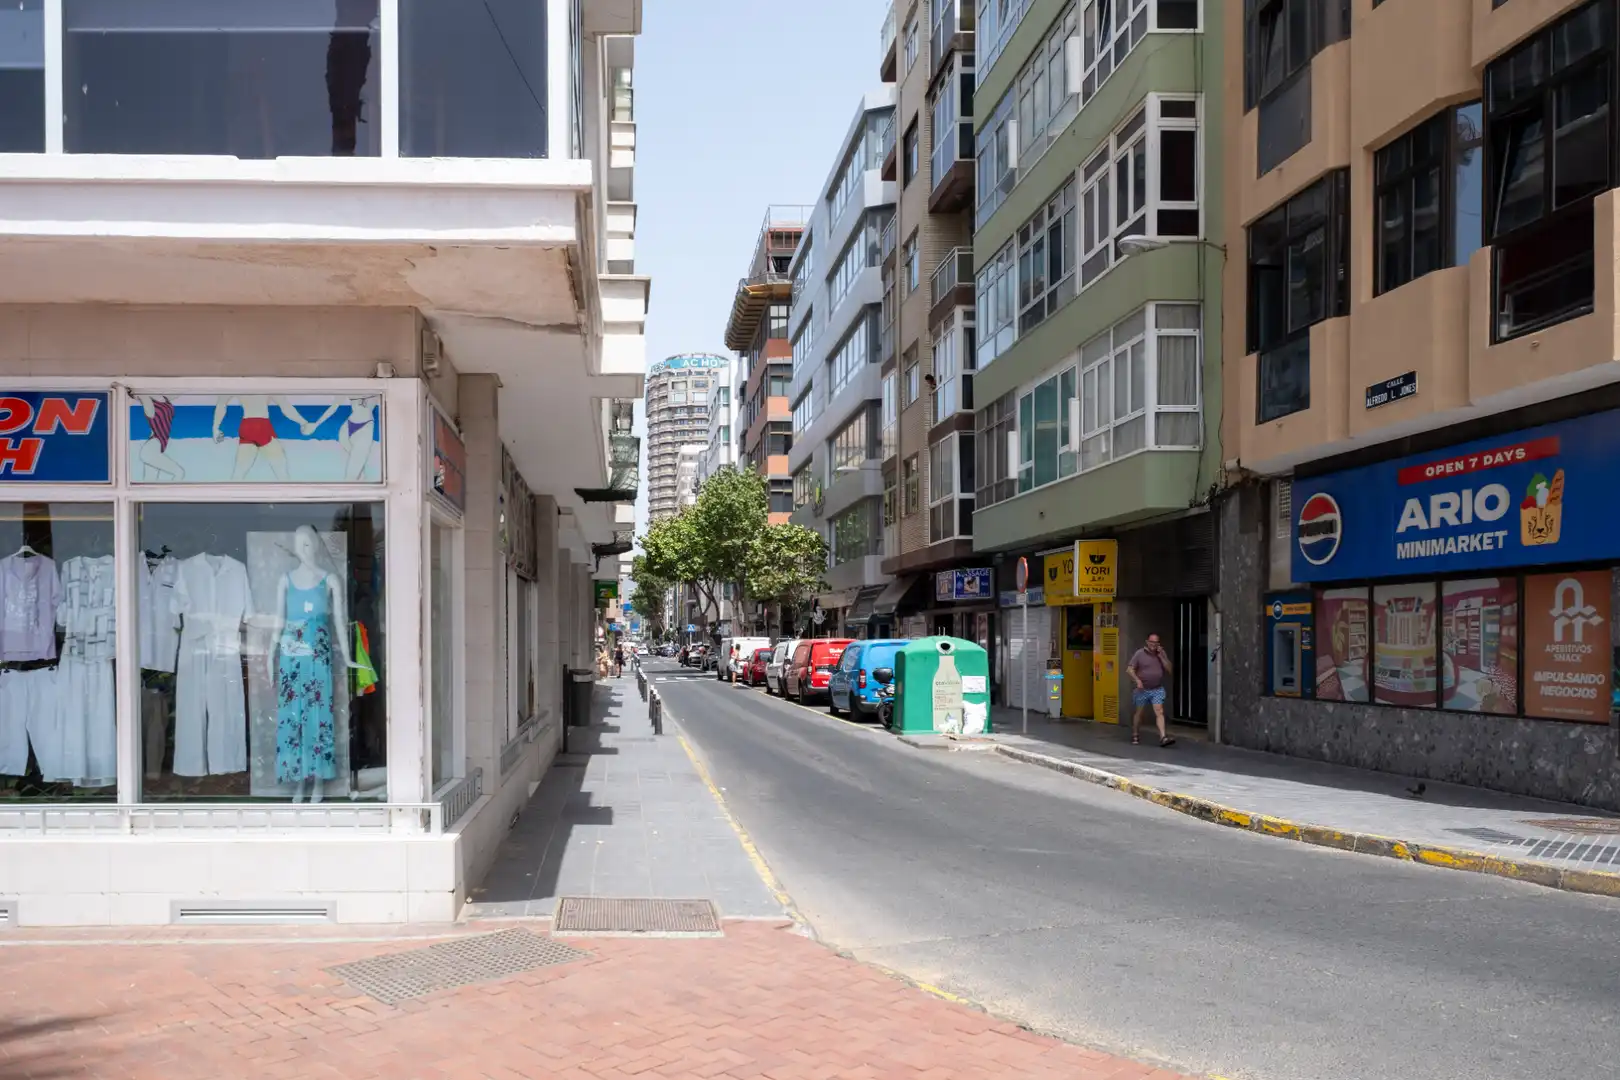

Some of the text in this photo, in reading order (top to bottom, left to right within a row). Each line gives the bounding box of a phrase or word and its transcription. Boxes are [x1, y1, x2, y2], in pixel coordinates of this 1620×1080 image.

[683, 358, 699, 367] AC
[1386, 377, 1404, 388] CALLE
[1366, 393, 1388, 407] ALFREDO
[1400, 382, 1416, 396] JONES
[1425, 448, 1527, 477] OPEN 7 DAYS
[1395, 483, 1511, 533] ARIO
[1396, 530, 1508, 560] MINIMARKET
[1085, 566, 1110, 575] YORI
[1553, 653, 1582, 662] SNACK
[1533, 671, 1606, 685] IMPULSANDO
[1539, 685, 1598, 699] NEGOCIOS
